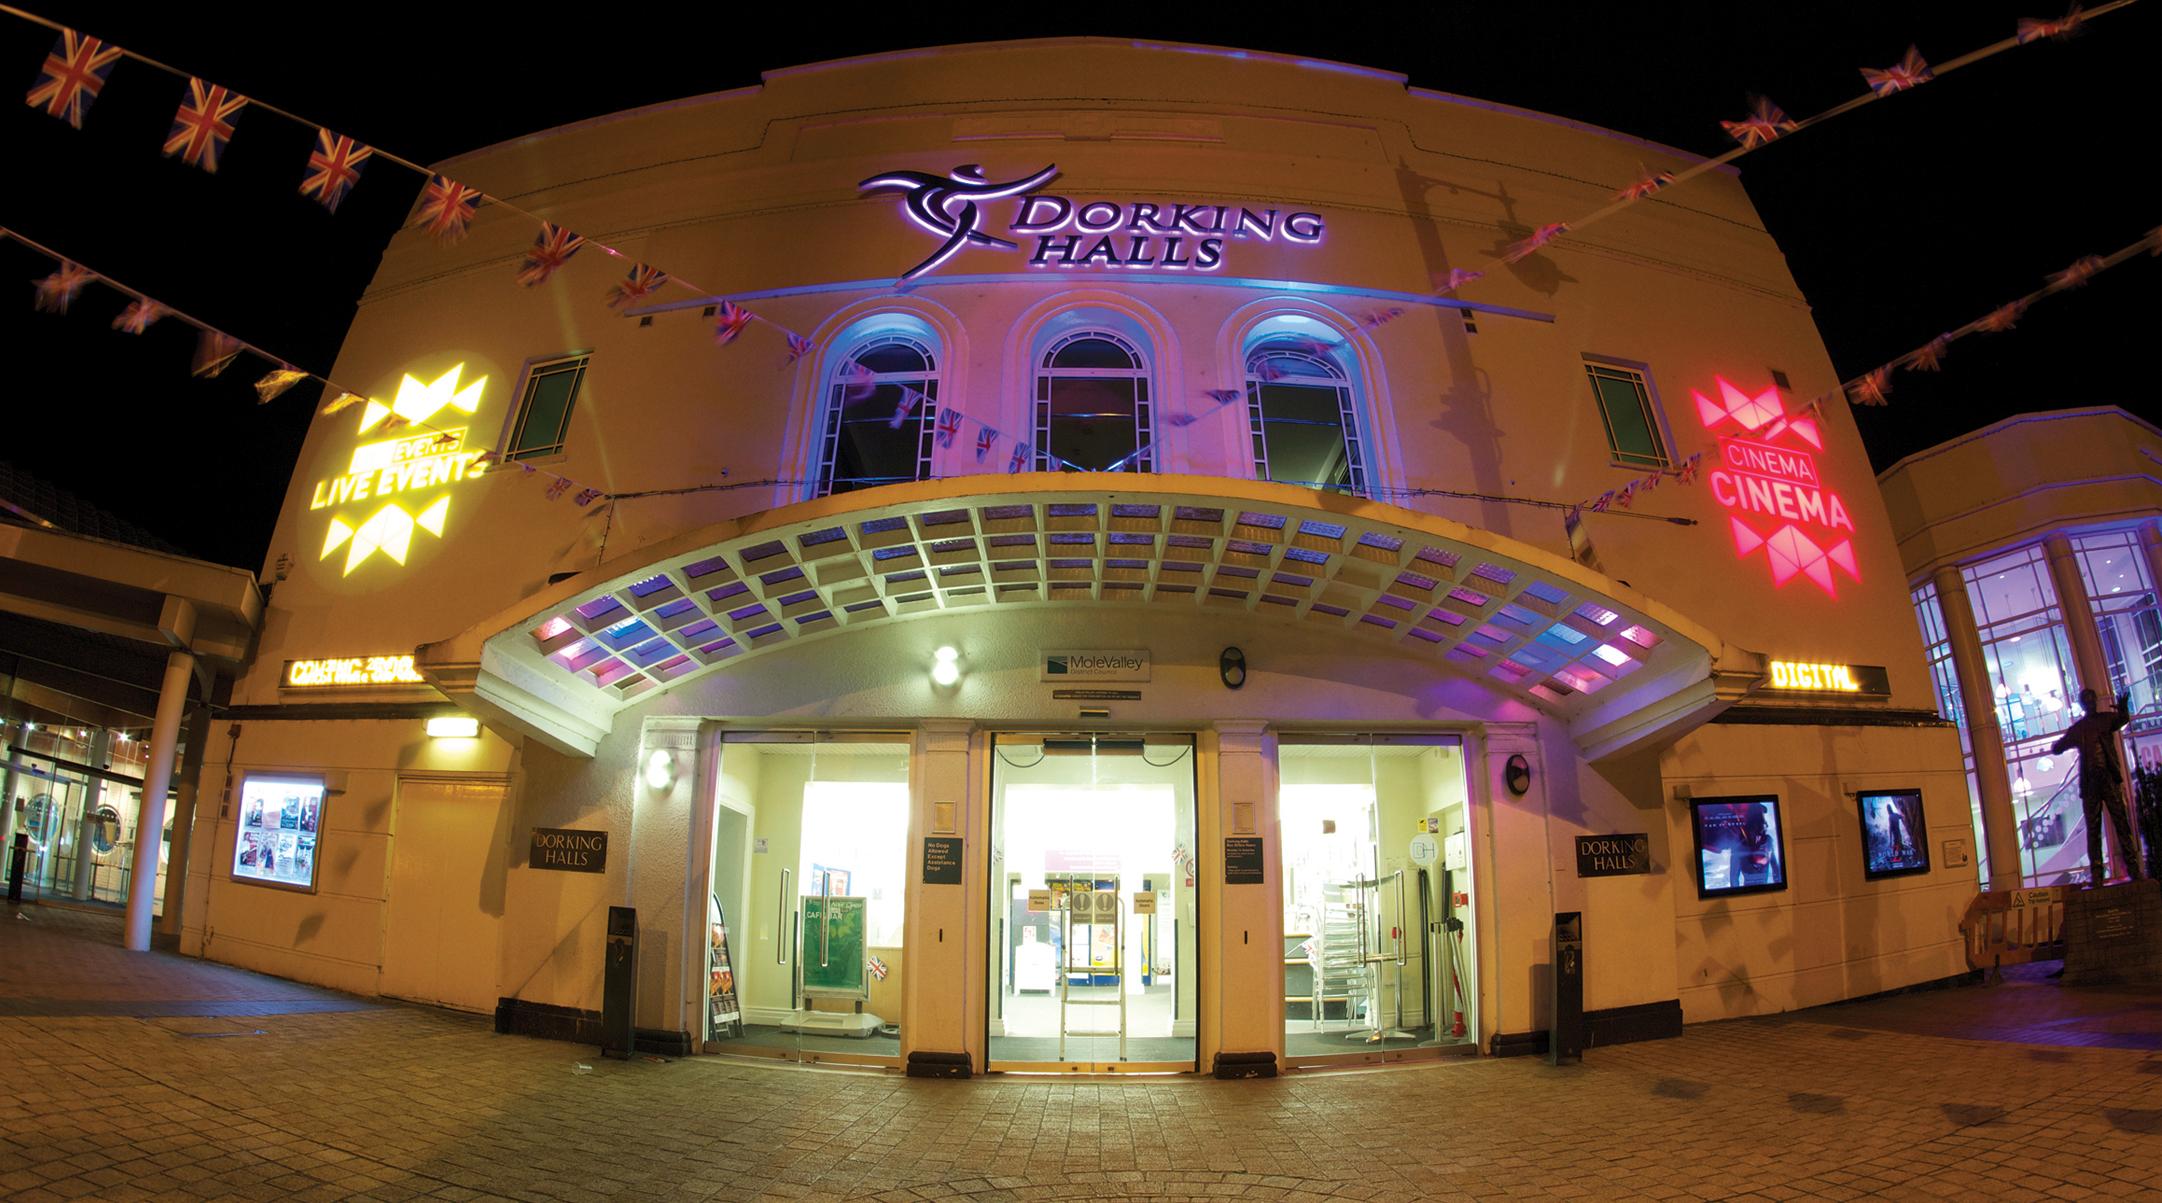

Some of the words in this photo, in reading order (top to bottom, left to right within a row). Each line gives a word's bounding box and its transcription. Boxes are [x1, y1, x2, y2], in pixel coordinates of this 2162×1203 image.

[1010, 195, 1325, 242] DORKING
[1029, 235, 1224, 270] HALLS
[310, 471, 375, 510] LIVE
[375, 449, 491, 496] EVENTS
[1727, 444, 1815, 480] CINEMA
[1710, 471, 1856, 532] CINEMA
[536, 833, 602, 851] DORKING
[545, 850, 588, 866] HALLS
[1581, 838, 1645, 856] DORKING
[1594, 855, 1636, 871] HALLS
